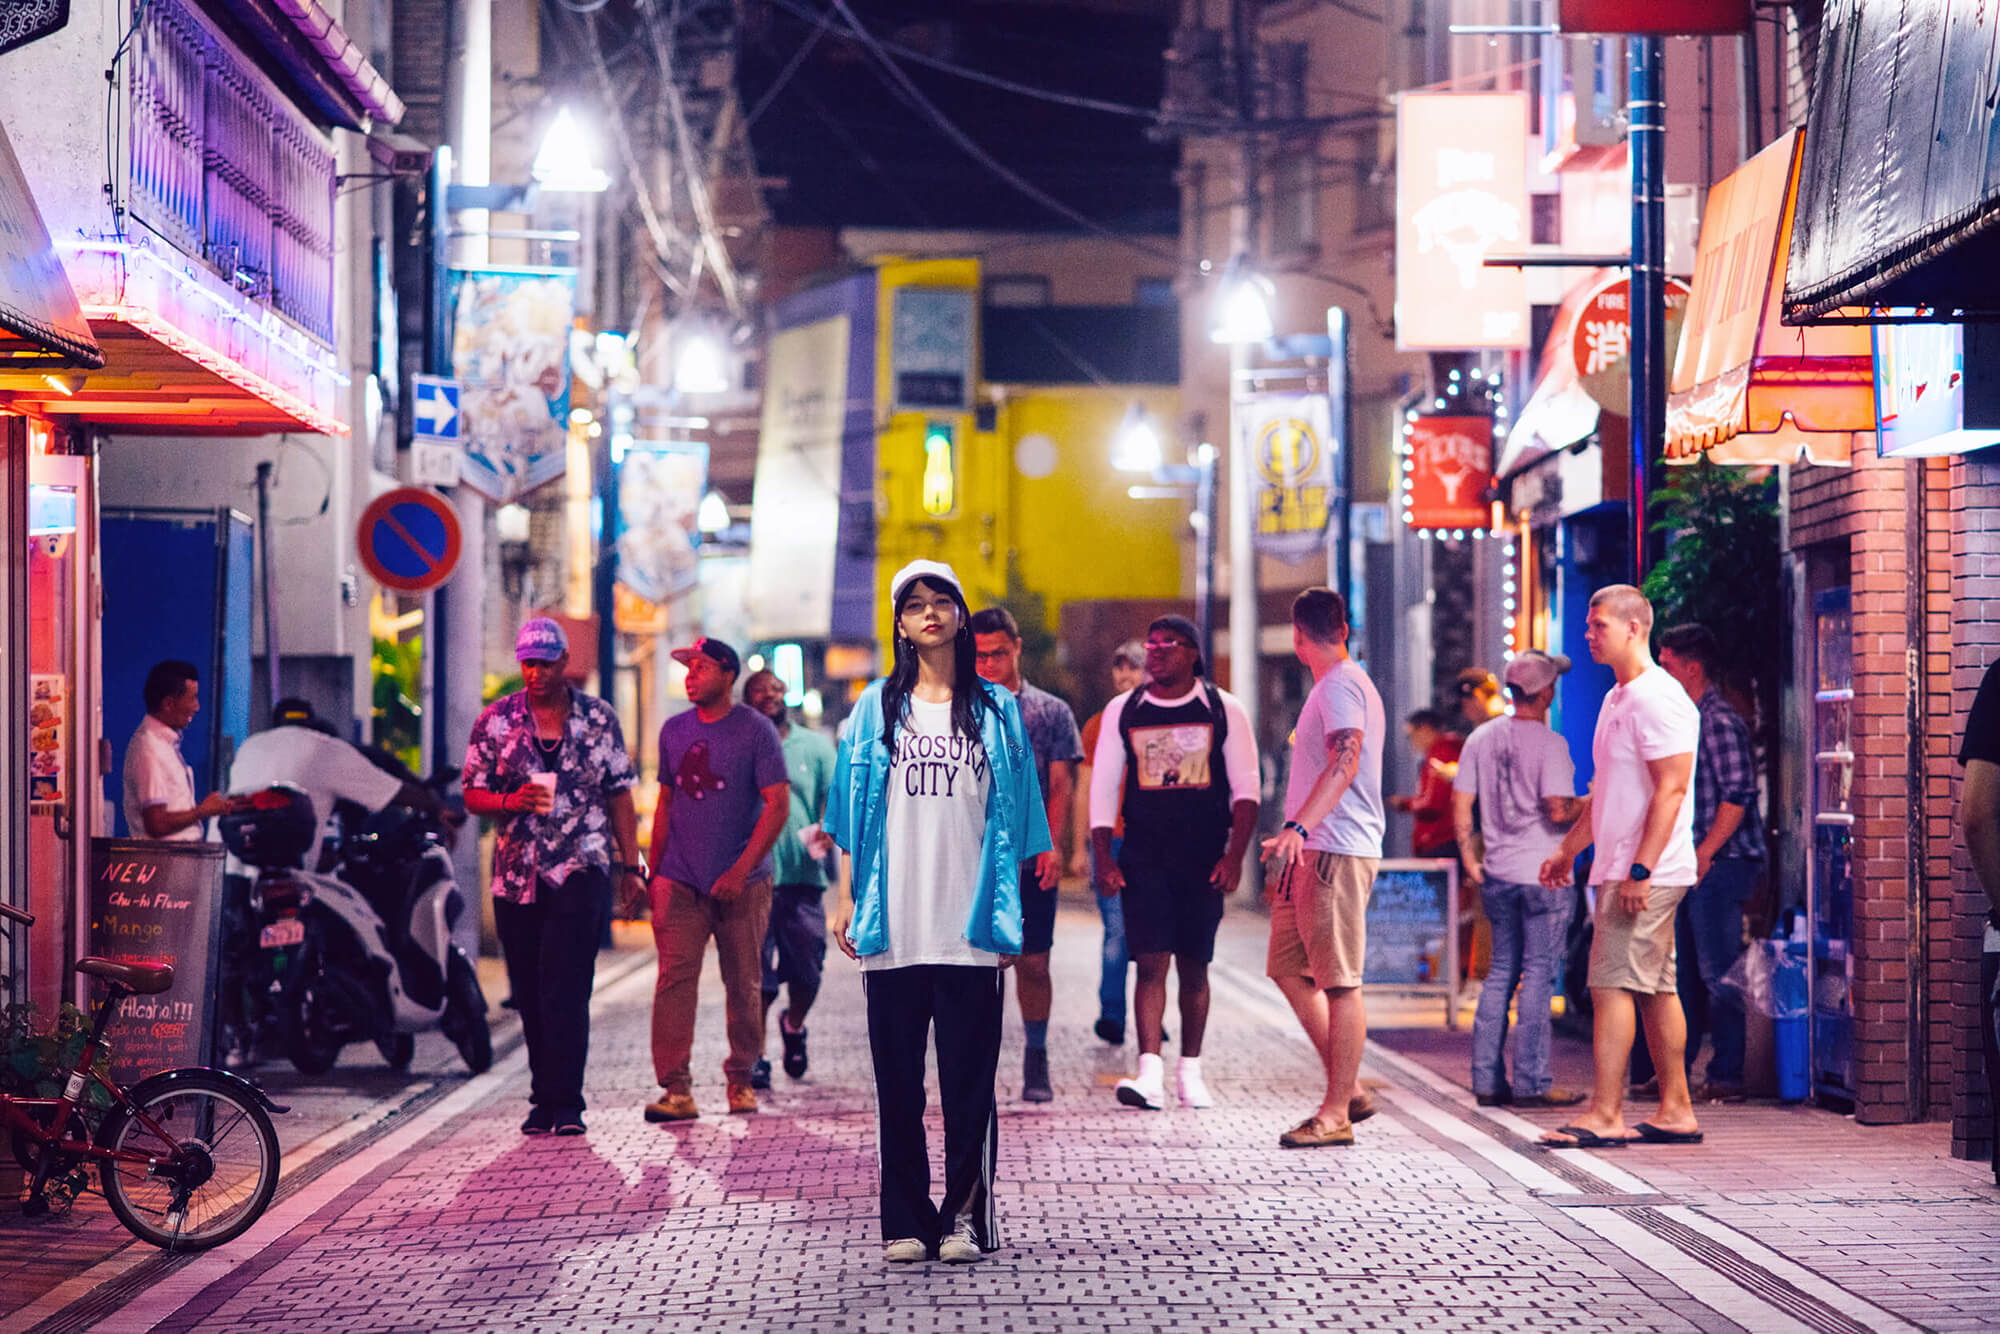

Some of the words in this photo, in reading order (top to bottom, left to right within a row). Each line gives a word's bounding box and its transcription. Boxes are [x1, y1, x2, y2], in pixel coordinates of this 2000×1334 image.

[1597, 293, 1626, 310] FIRE
[1585, 319, 1631, 375] 消
[890, 735, 987, 782] OKOSUKA
[905, 761, 959, 797] CITY
[101, 863, 157, 885] NEW
[153, 892, 192, 909] Flavor
[104, 914, 163, 942] Mango
